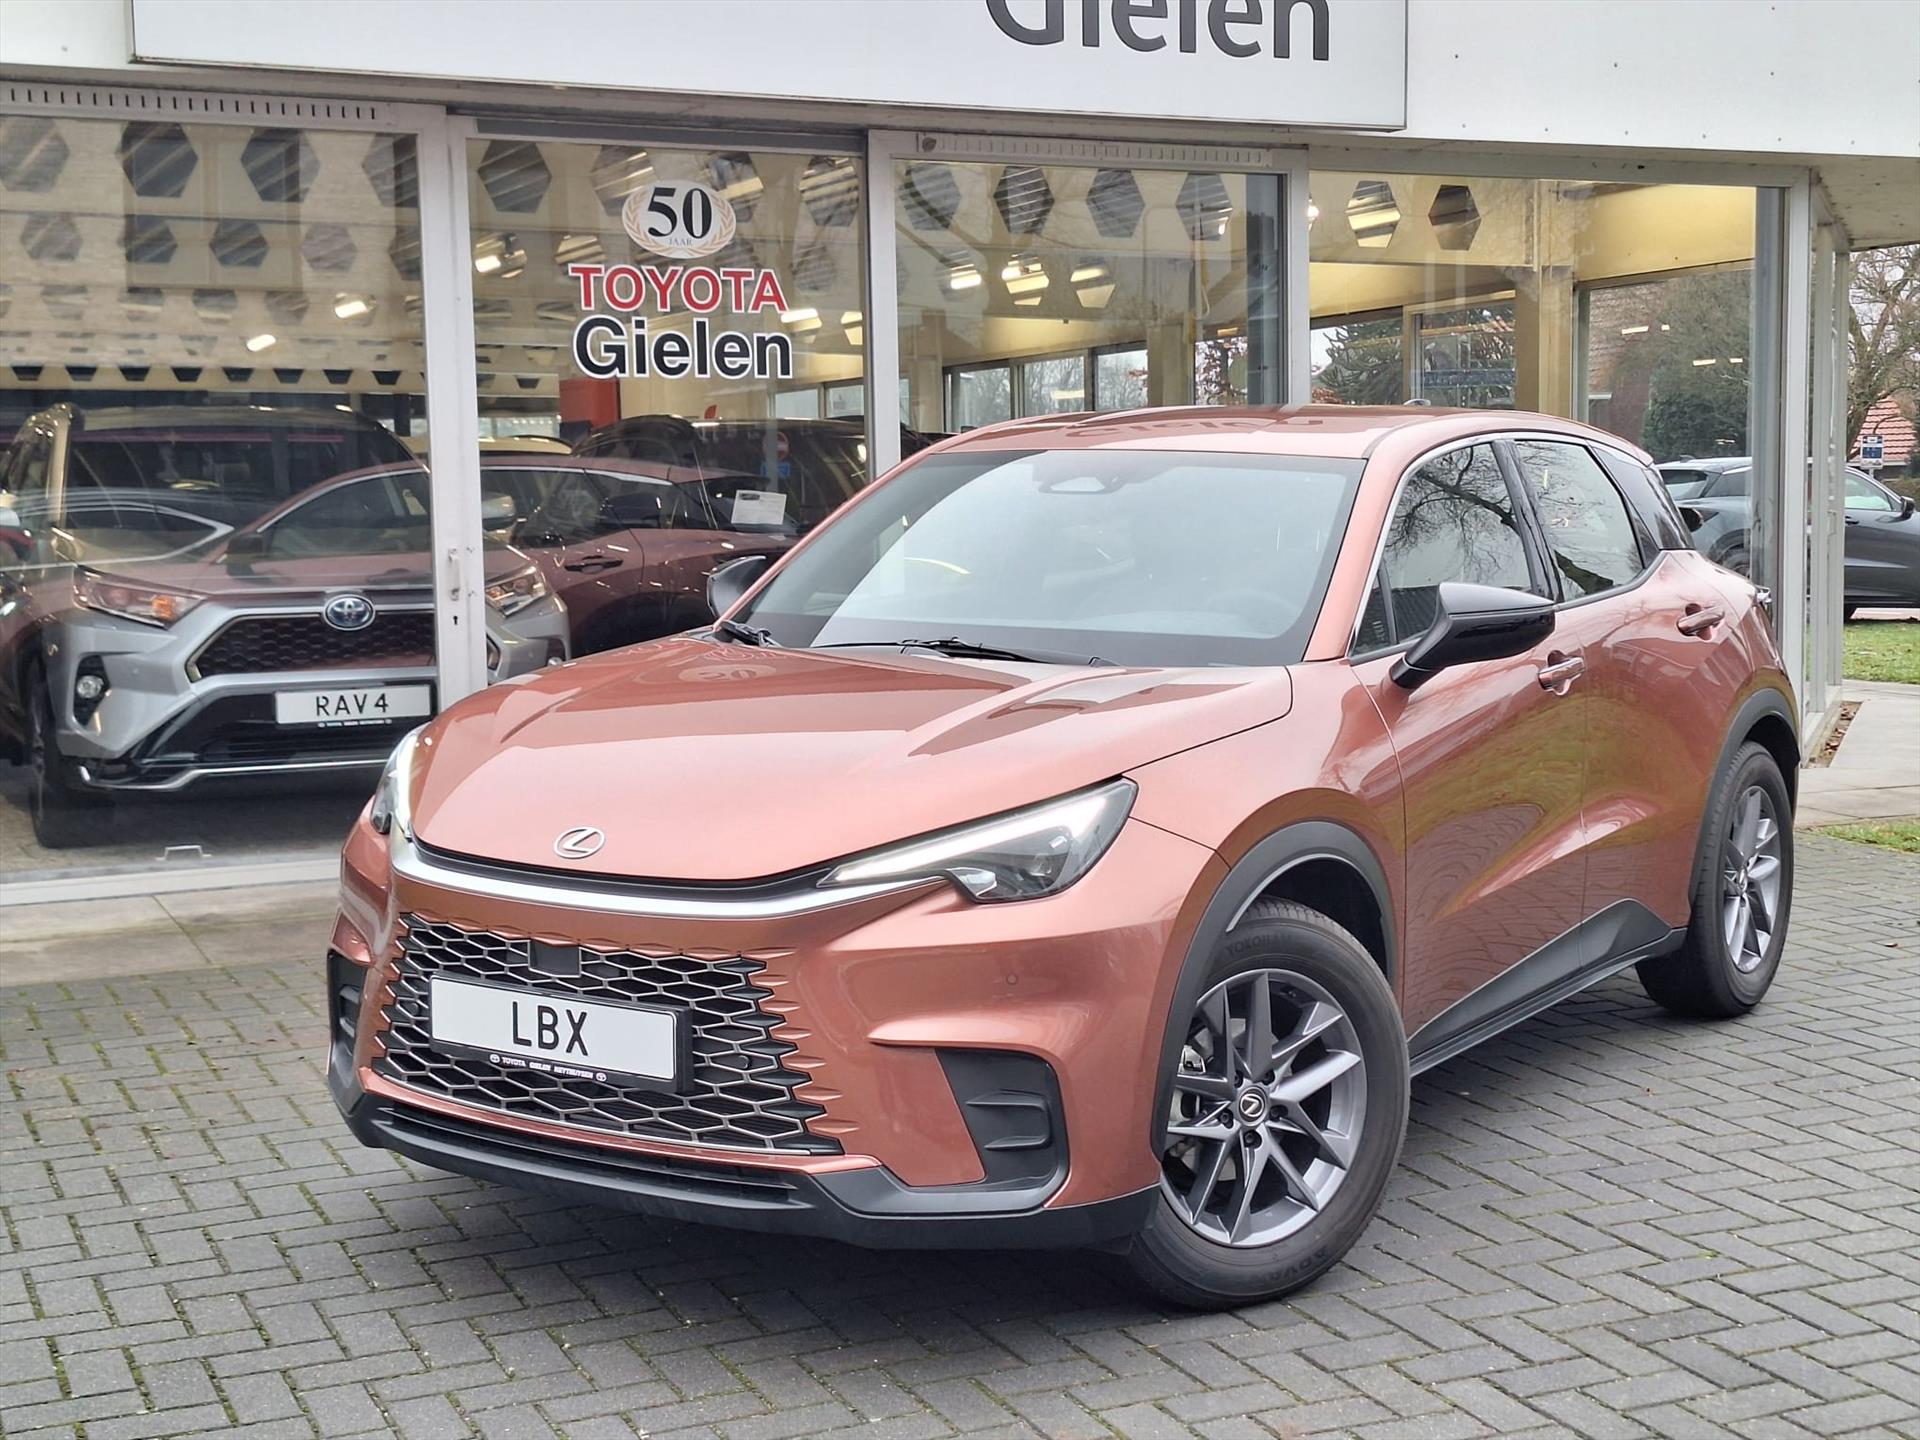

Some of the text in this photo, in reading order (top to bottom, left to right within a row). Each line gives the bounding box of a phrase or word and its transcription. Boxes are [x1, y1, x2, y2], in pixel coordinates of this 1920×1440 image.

[648, 187, 712, 238] 50
[668, 238, 693, 246] JAAR
[569, 264, 790, 313] TOYOTA
[574, 315, 793, 379] Gielen
[511, 1001, 588, 1056] LBX
[501, 1056, 526, 1067] TOYOTA
